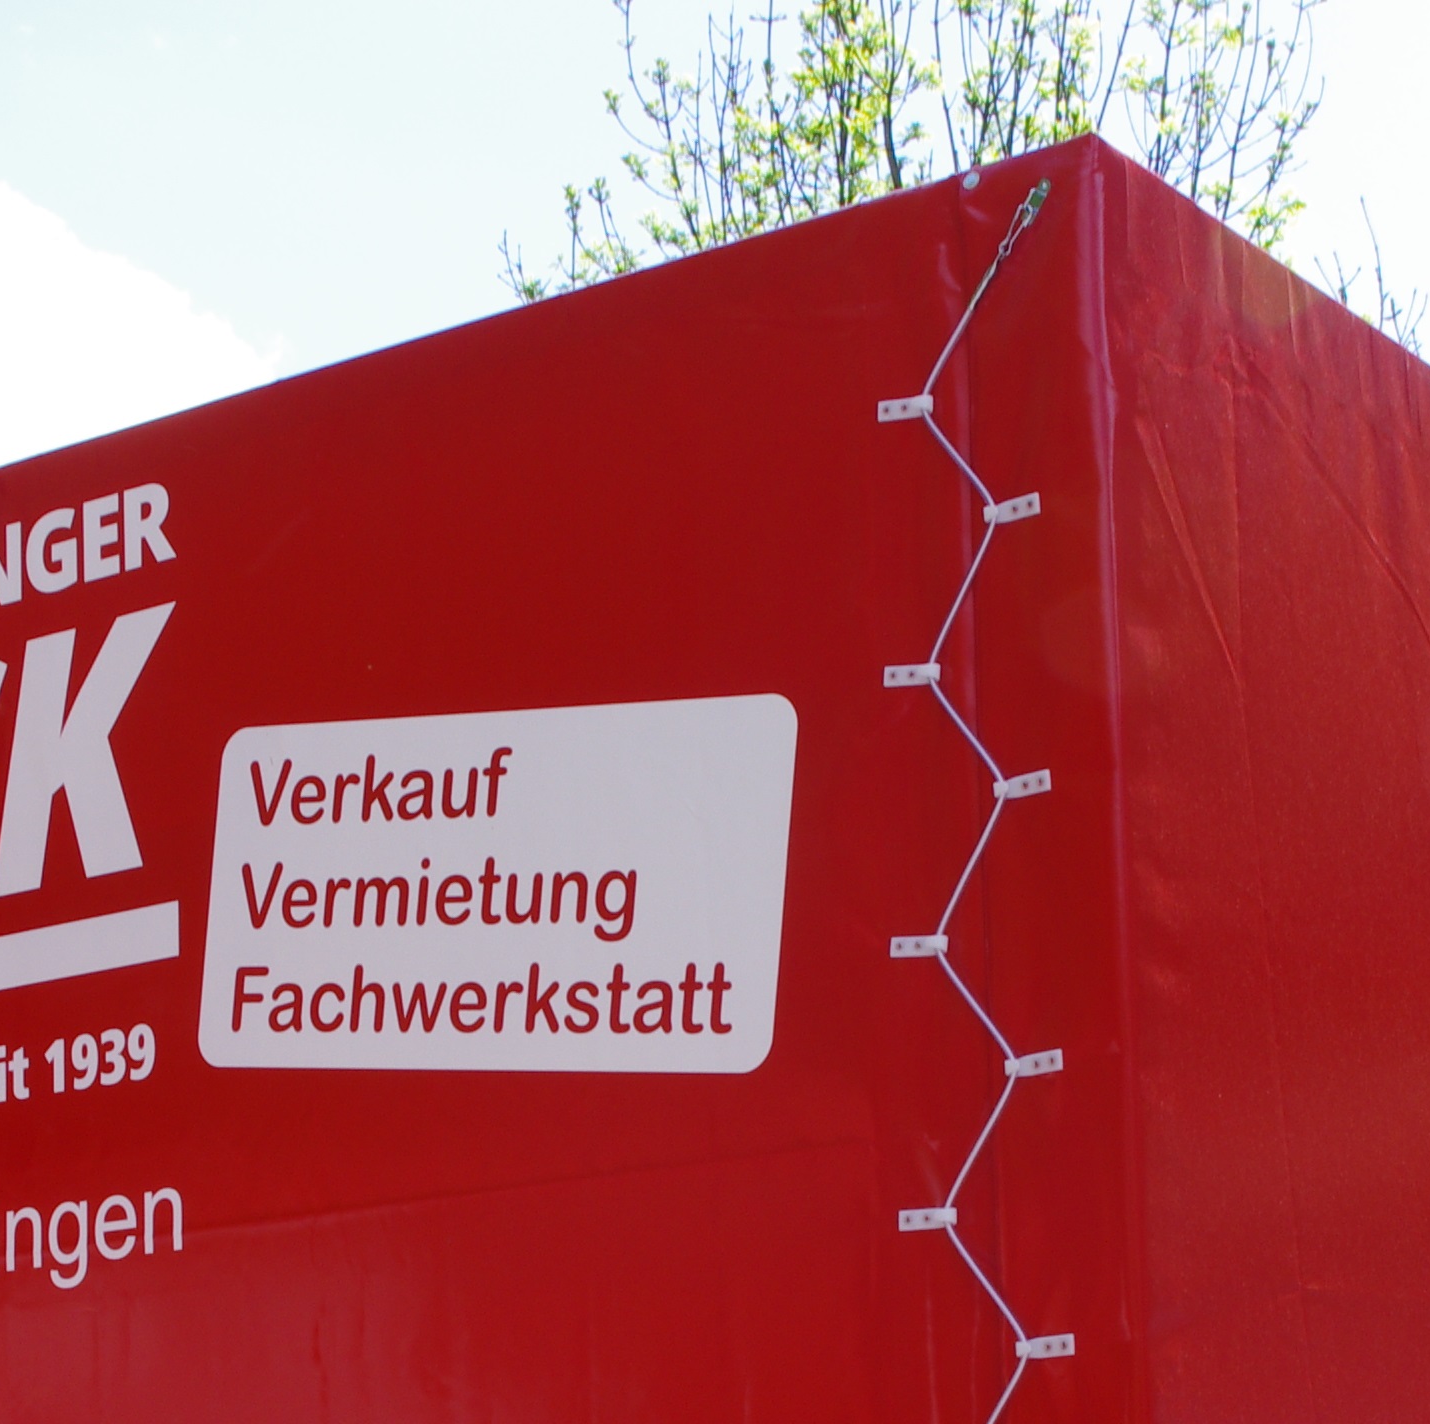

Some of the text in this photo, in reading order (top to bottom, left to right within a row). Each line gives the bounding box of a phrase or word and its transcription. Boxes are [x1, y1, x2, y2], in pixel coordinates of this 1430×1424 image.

[251, 748, 512, 826] Verkauf
[242, 858, 637, 942] Vermietung
[232, 963, 731, 1034] Fachwerkstatt
[45, 1024, 155, 1093] 1939
